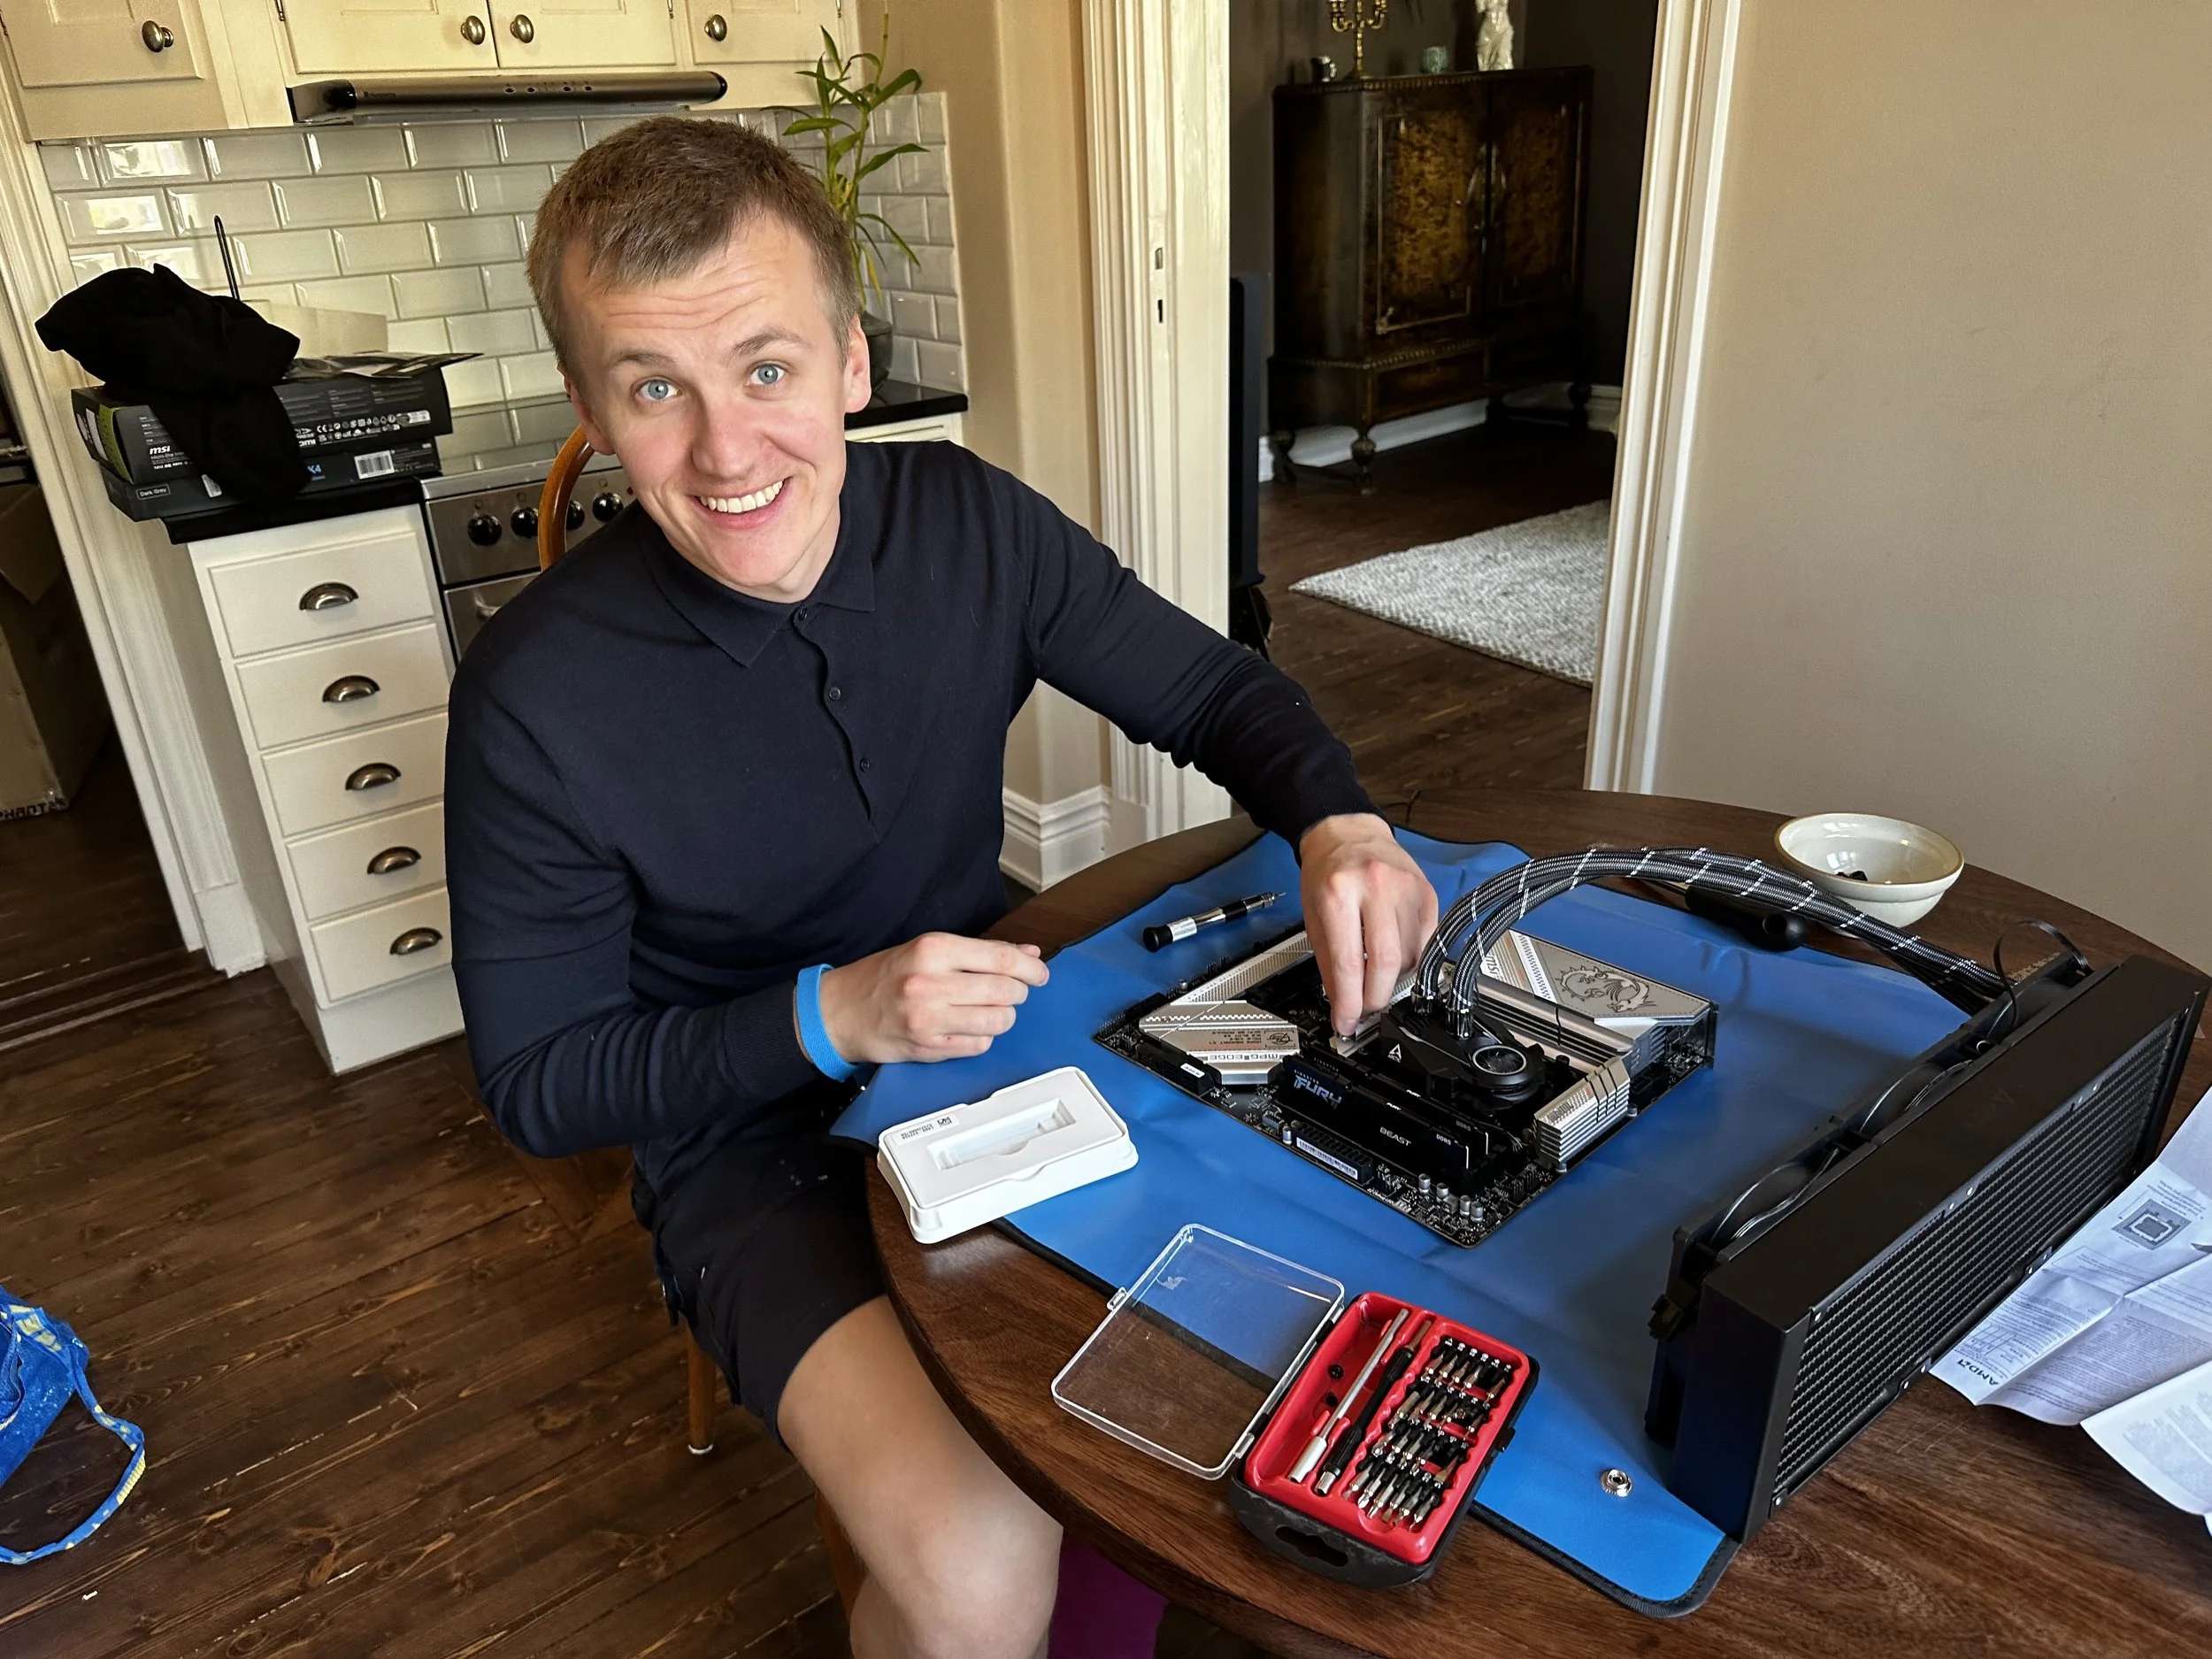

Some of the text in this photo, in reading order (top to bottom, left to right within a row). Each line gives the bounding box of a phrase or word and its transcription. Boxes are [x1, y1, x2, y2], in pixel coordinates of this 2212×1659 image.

[149, 445, 171, 456] msi
[1486, 955, 1501, 974] msi
[1294, 1073, 1342, 1110] FURY
[1380, 1126, 1411, 1147] BEAST
